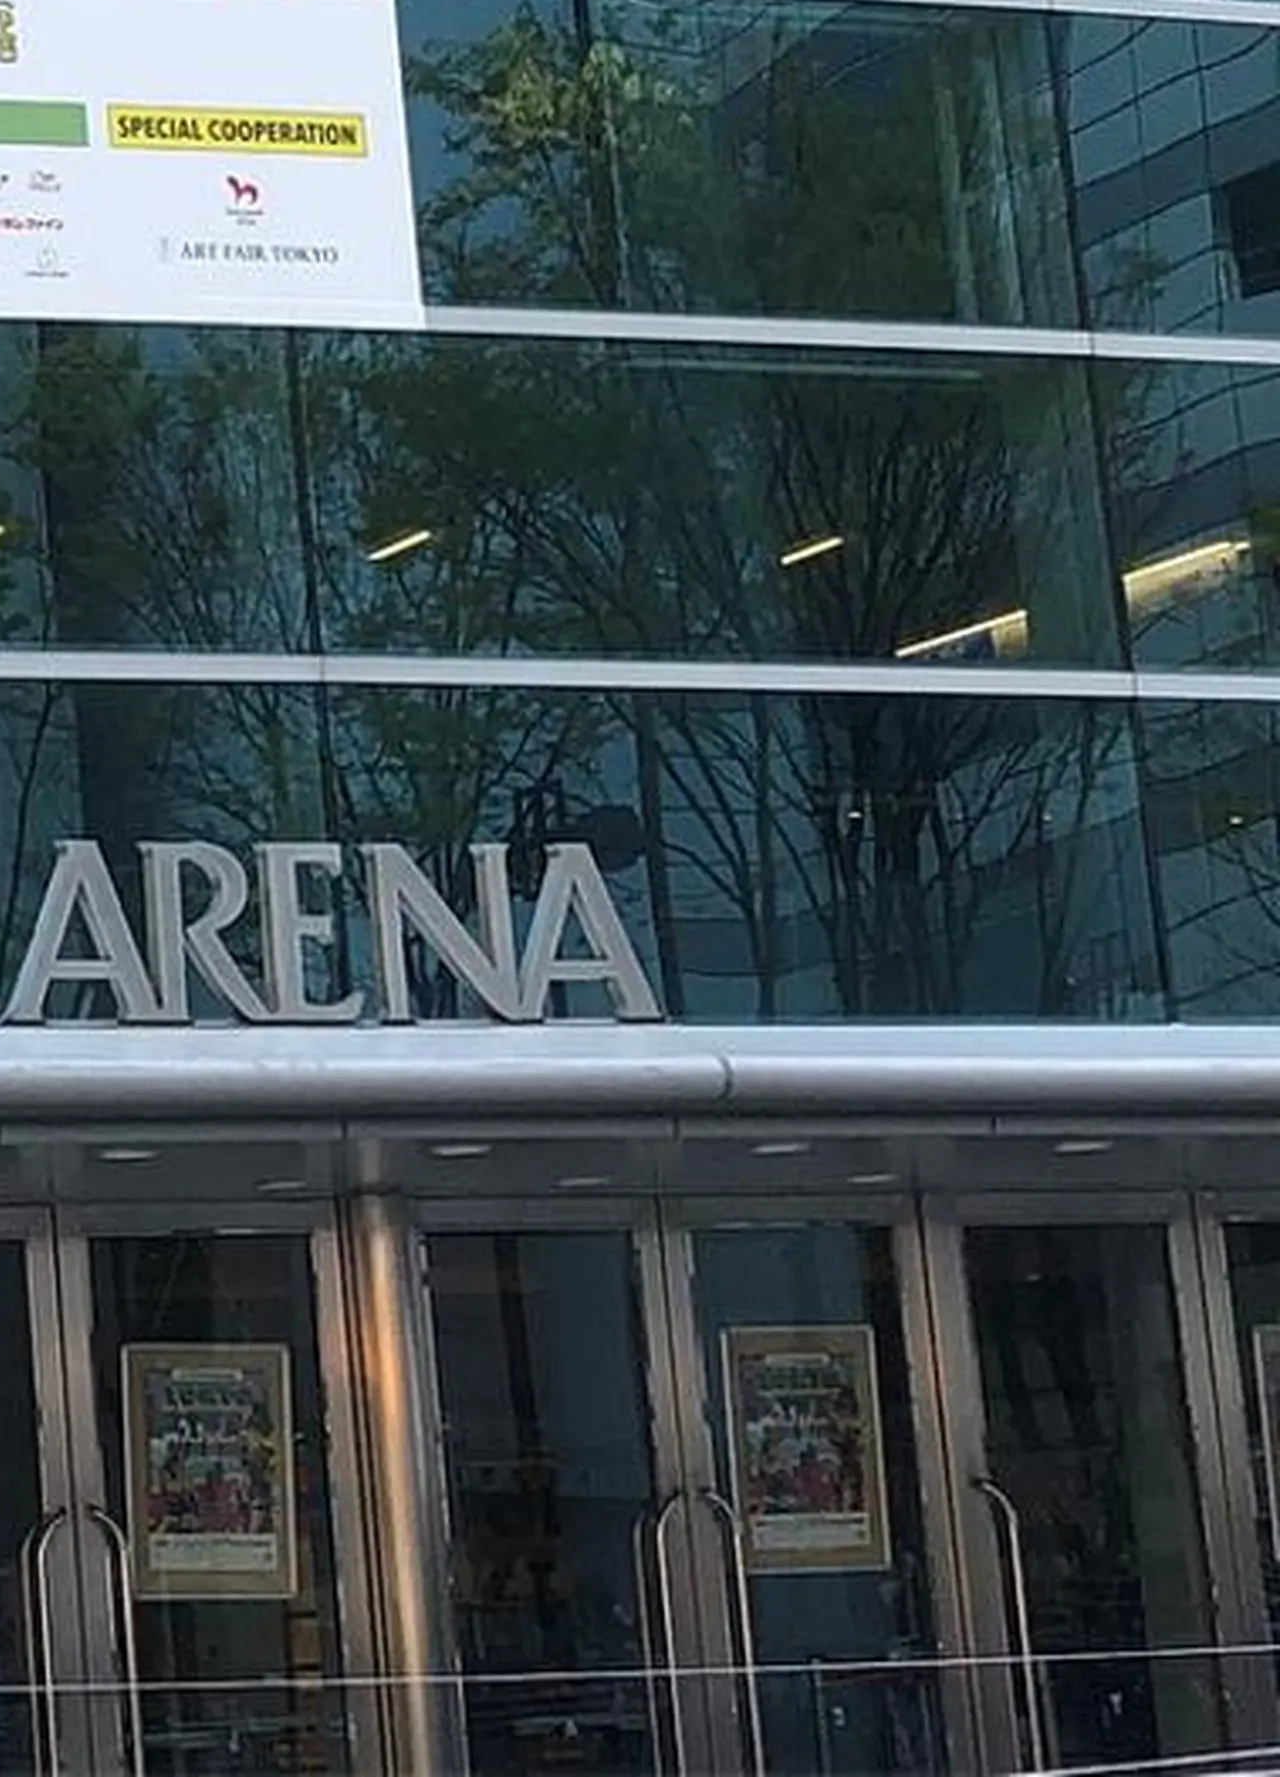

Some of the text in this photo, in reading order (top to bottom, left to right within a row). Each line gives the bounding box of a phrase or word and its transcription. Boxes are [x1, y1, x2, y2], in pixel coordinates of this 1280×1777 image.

[116, 115, 359, 146] SPECIAL COOPERATION
[0, 838, 667, 1024] ARENA
